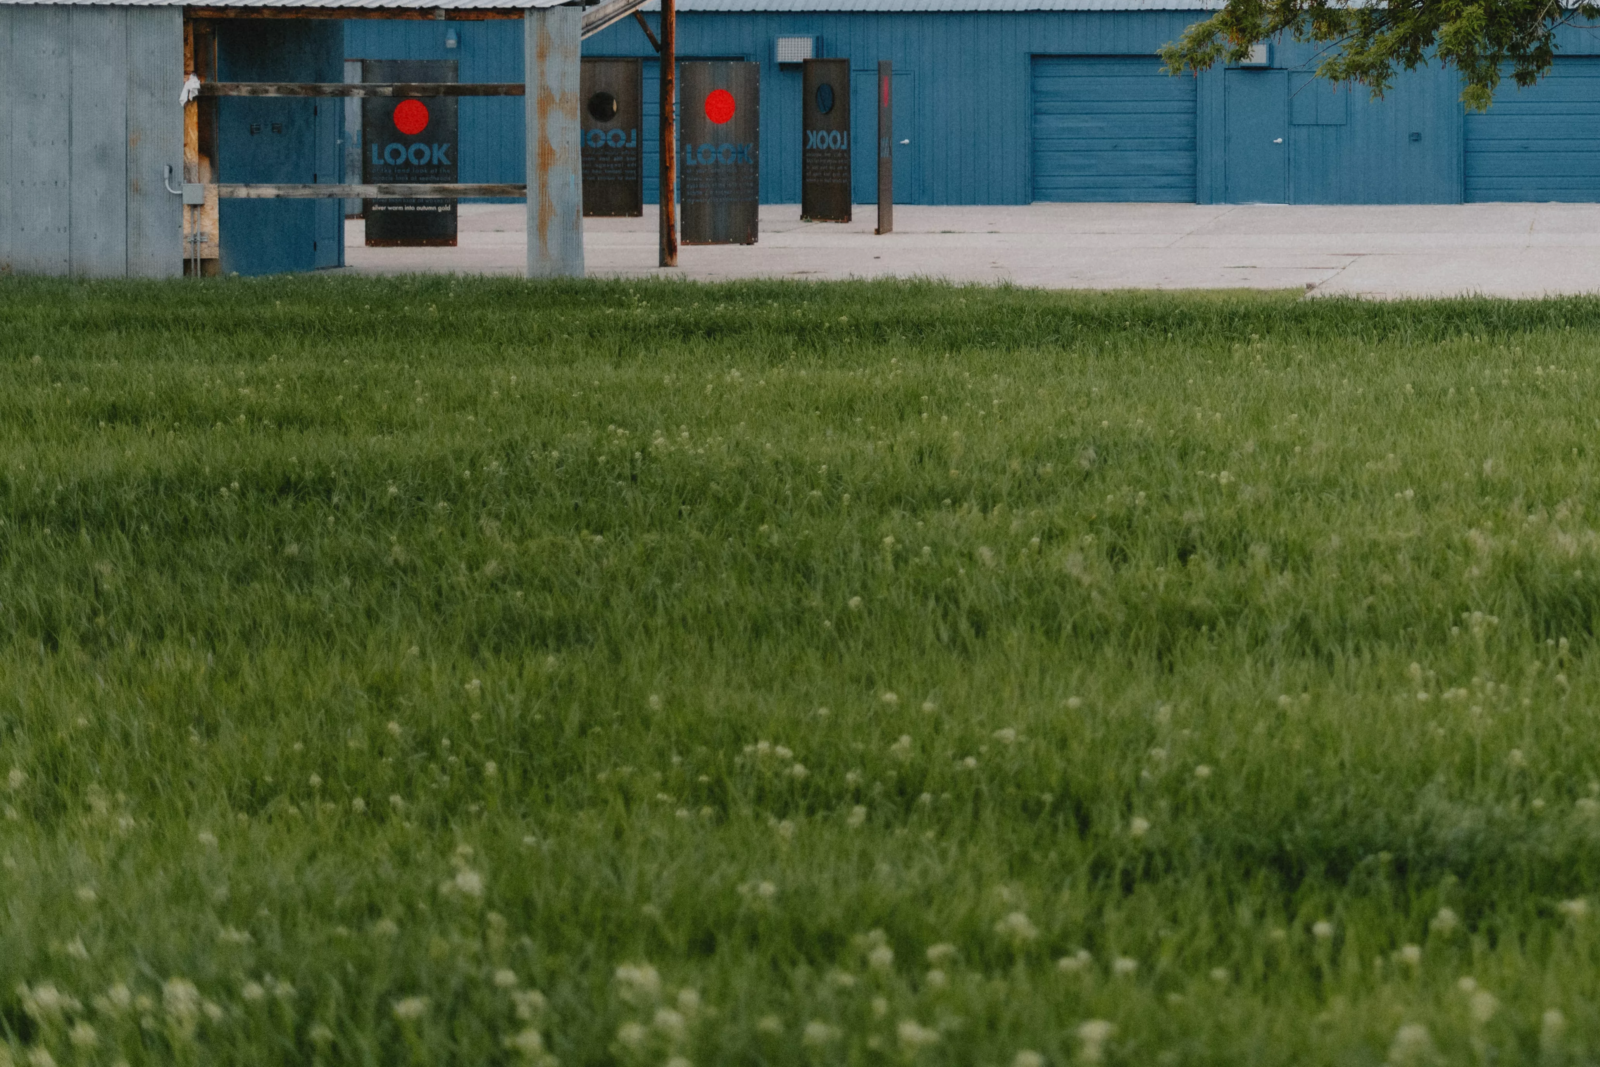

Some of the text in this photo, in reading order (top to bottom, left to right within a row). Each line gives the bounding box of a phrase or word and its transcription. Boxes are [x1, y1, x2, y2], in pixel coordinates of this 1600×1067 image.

[372, 142, 451, 166] LOOK
[686, 142, 754, 166] LOOK
[437, 204, 451, 212] gold
